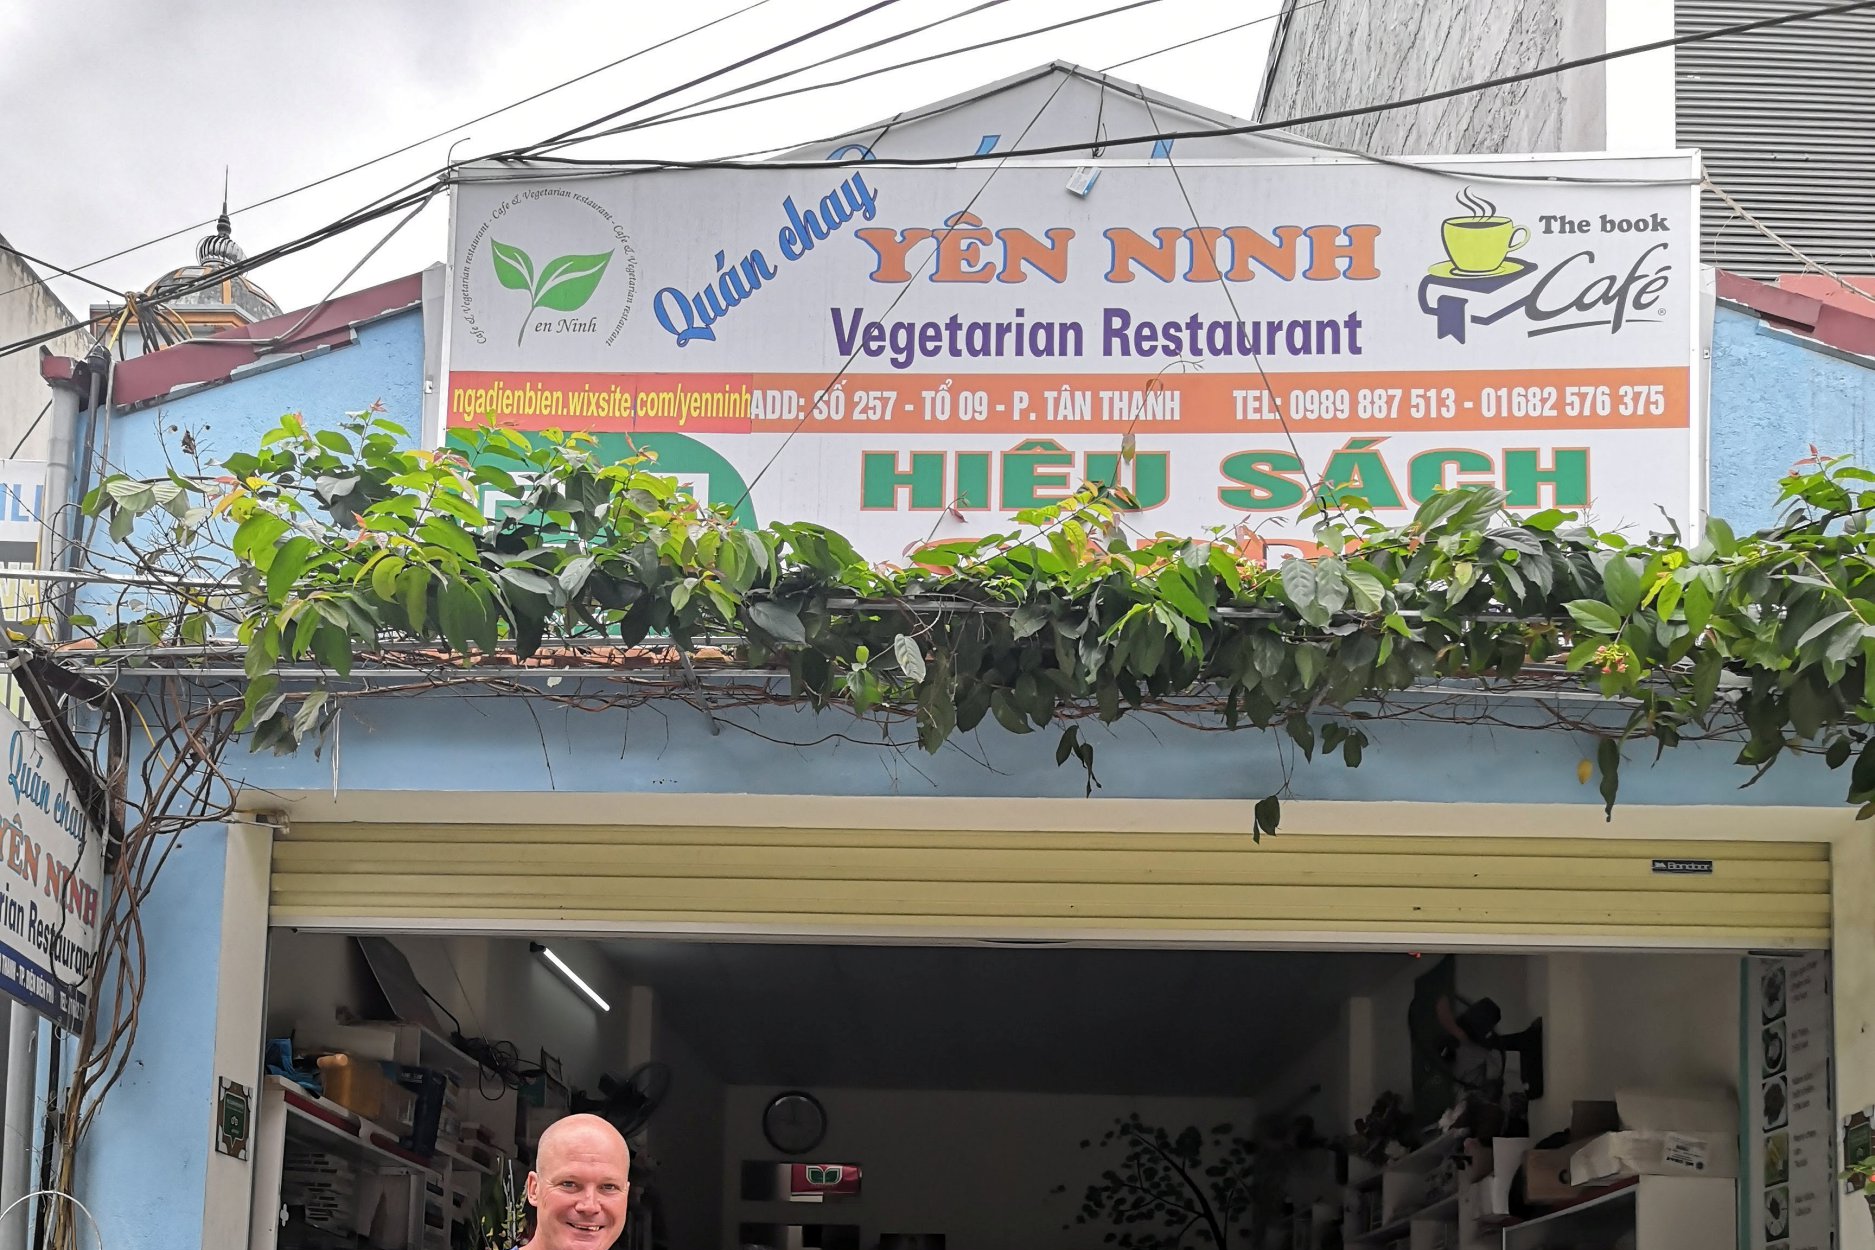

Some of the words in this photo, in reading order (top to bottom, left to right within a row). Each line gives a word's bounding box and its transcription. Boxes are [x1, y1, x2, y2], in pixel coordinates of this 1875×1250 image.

[492, 202, 510, 220] Cafe
[522, 188, 572, 201] Vegetarian
[573, 193, 613, 221] restaurant
[466, 223, 489, 264] restaurant
[613, 225, 628, 244] Cafe
[1539, 215, 1591, 234] The
[1599, 213, 1670, 234] book
[653, 249, 778, 347] Quán
[778, 170, 878, 261] chay
[855, 211, 1076, 284] YÊN
[1103, 225, 1381, 284] NINH
[461, 269, 473, 313] Vegetarian
[625, 255, 638, 304] Vegetarian
[1525, 242, 1672, 334] Café
[535, 322, 552, 333] en
[556, 317, 598, 333] Ninh
[605, 306, 631, 347] restaurant
[830, 307, 1084, 369] Vegetarian
[1102, 310, 1363, 357] Restaurant
[453, 381, 751, 425] ngadienbien.wixsite.com/yenninh
[751, 388, 804, 420] ADD:
[812, 379, 847, 420] SỐ
[853, 390, 897, 420] 257
[922, 378, 952, 420] TỔ
[958, 390, 988, 420] 09
[1013, 390, 1036, 420] P.
[1043, 384, 1091, 420] TÂN
[1099, 390, 1180, 420] THANH
[1233, 389, 1281, 419] TEL:
[1289, 388, 1349, 420] 0989
[1357, 388, 1402, 419] 887
[1410, 387, 1455, 418] 513
[1481, 386, 1557, 418] 01682
[1565, 385, 1611, 416] 576
[1619, 384, 1664, 416] 375
[1218, 436, 1590, 512] SÁCH
[8, 730, 50, 815] Quán
[44, 853, 98, 928] NINH
